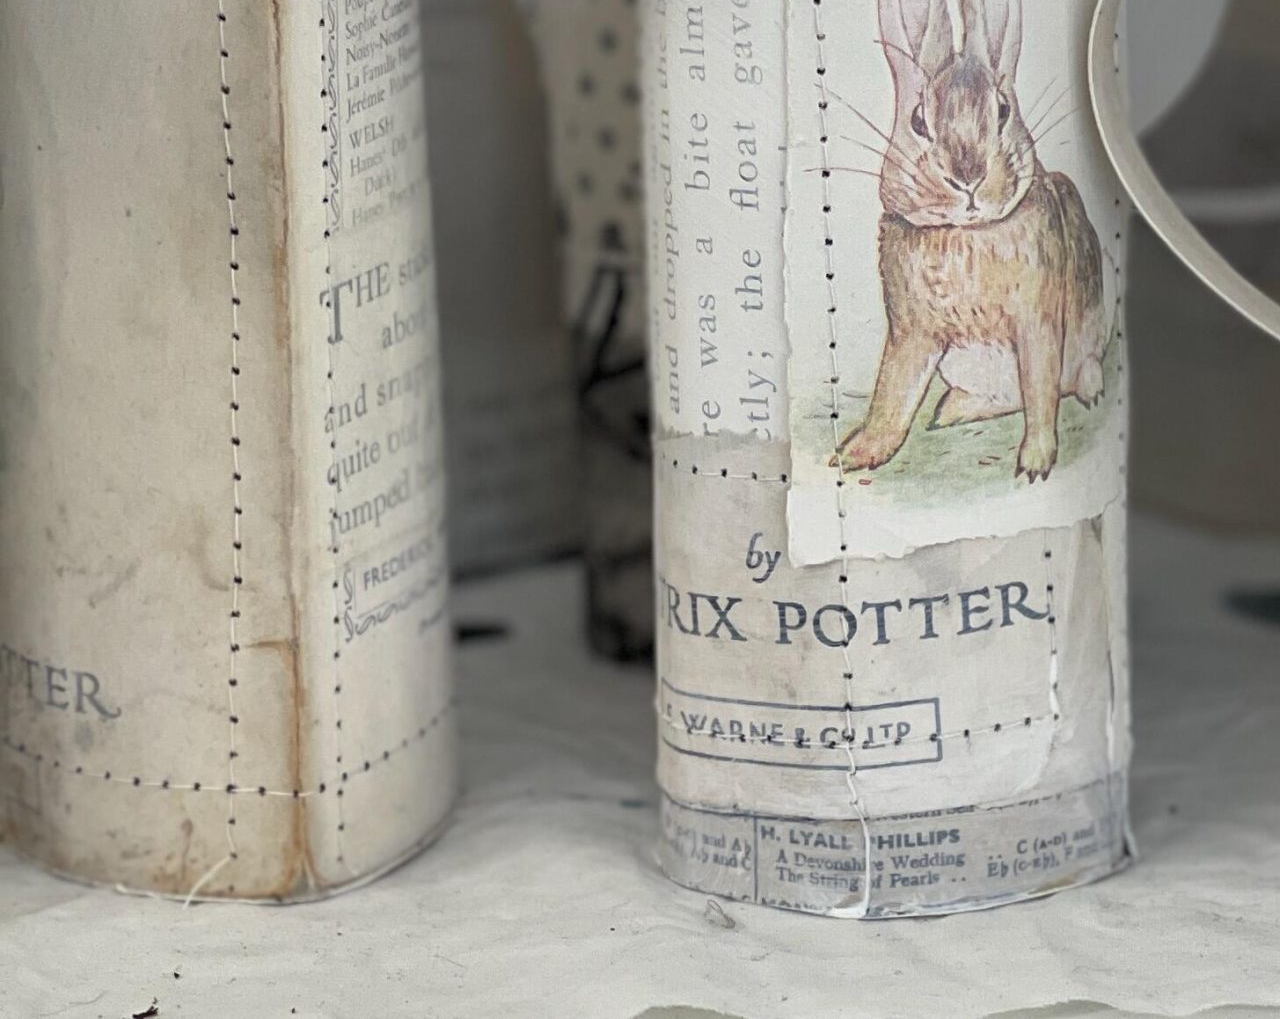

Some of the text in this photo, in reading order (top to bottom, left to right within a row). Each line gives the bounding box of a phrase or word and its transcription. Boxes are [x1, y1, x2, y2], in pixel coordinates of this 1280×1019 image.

[346, 71, 360, 92] La
[349, 114, 395, 150] WELSH
[684, 112, 711, 191] bite
[728, 120, 760, 212] float
[659, 163, 680, 321] dropped
[695, 236, 714, 256] a
[320, 261, 391, 345] THE
[734, 248, 764, 313] the
[697, 293, 719, 368] was
[664, 344, 681, 416] and
[324, 383, 369, 433] and
[327, 439, 381, 493] quite
[328, 468, 410, 552] jumped
[745, 532, 782, 583] by
[659, 576, 1051, 649] RIX POTTER
[680, 711, 785, 747] WARNE
[760, 824, 782, 843] H.
[789, 828, 854, 850] LYALL
[775, 848, 789, 865] A
[890, 852, 966, 870] Wedding
[1016, 838, 1029, 855] C
[775, 866, 941, 892] The String Pearls
